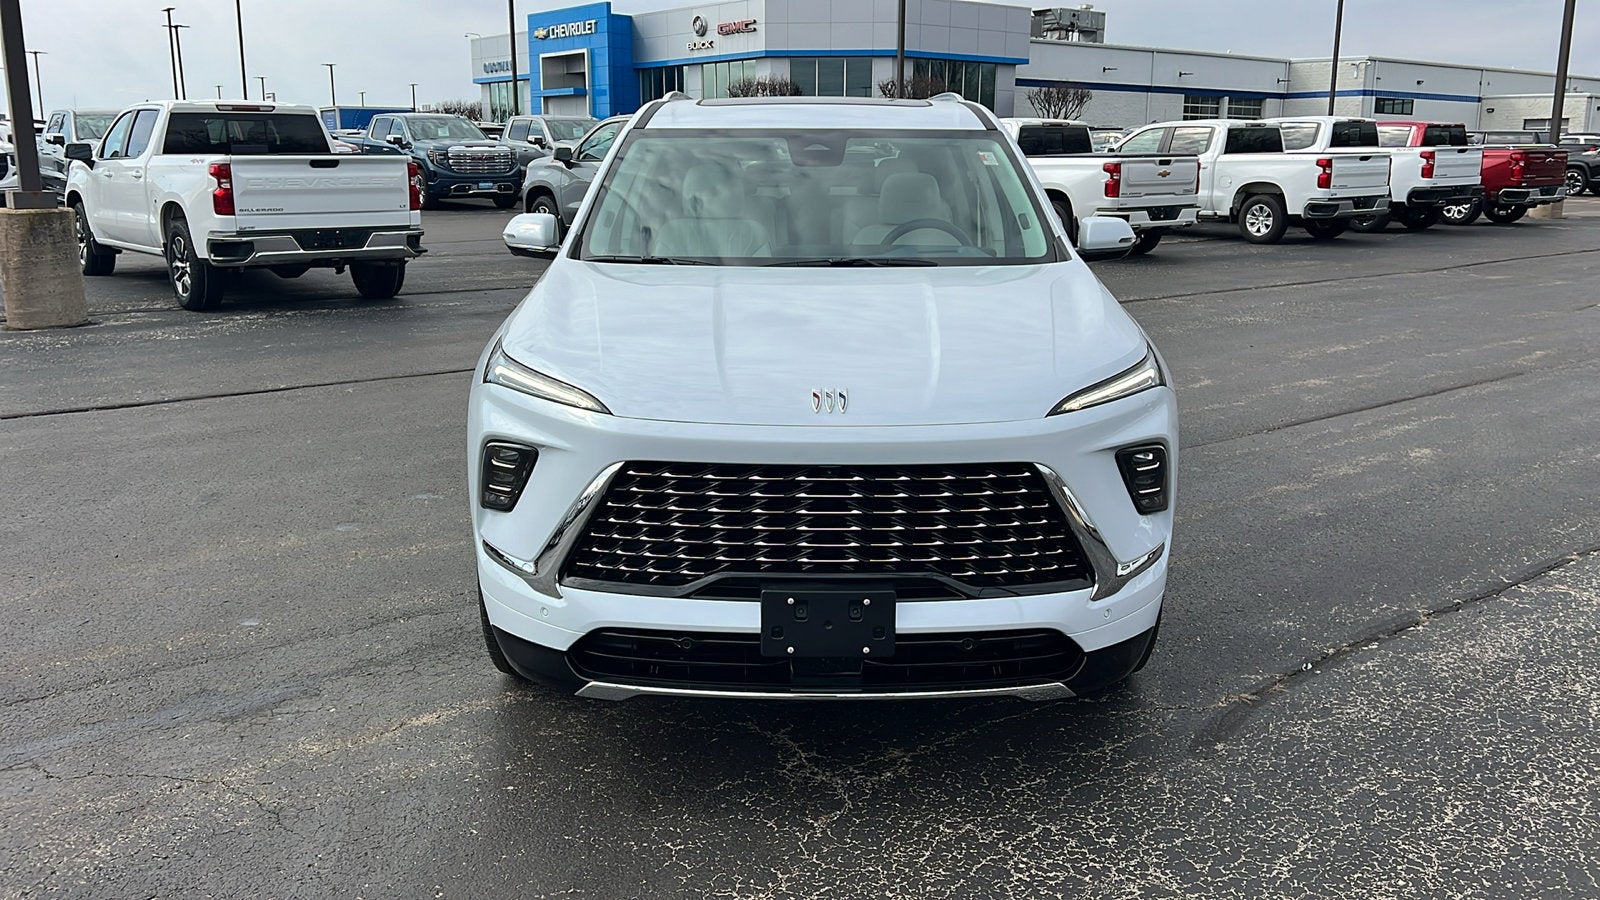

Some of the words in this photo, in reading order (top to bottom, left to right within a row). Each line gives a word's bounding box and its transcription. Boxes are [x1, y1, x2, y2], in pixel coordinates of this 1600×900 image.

[549, 19, 597, 39] CHEVROLET
[717, 20, 756, 35] GMC
[687, 41, 713, 50] BUICK
[247, 177, 397, 189] CHEVROLET
